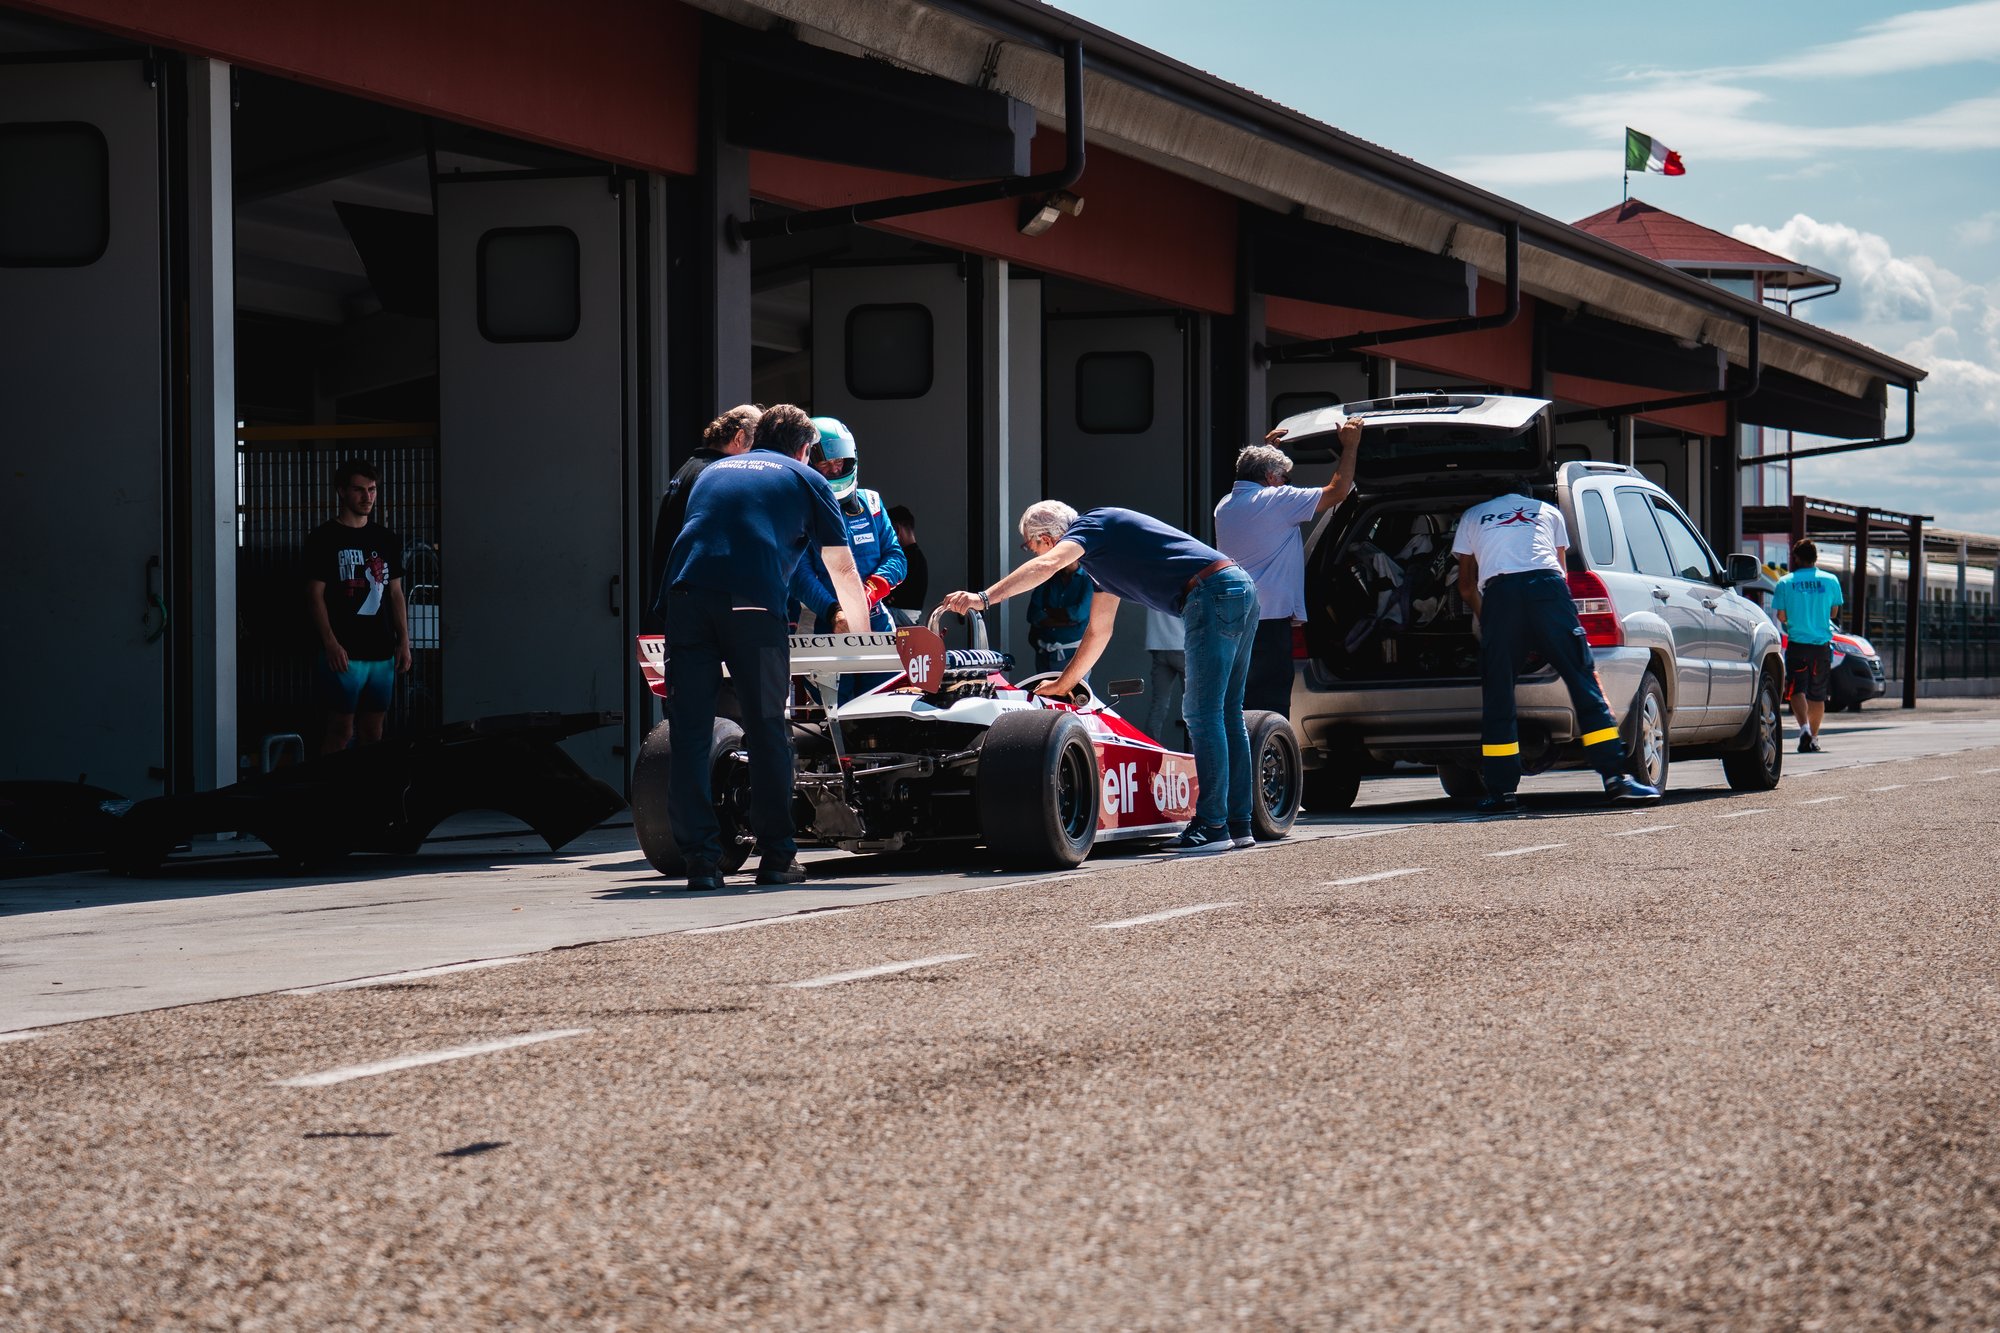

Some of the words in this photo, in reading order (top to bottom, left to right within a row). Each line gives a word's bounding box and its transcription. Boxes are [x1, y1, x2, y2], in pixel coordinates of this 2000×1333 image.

[748, 460, 783, 470] HISTORIC
[337, 549, 365, 566] GREEN
[339, 565, 356, 581] DAY
[789, 636, 836, 648] JECT
[843, 635, 897, 647] CLUB
[908, 654, 930, 683] elf
[1103, 762, 1138, 815] elf
[1153, 760, 1190, 812] olio
